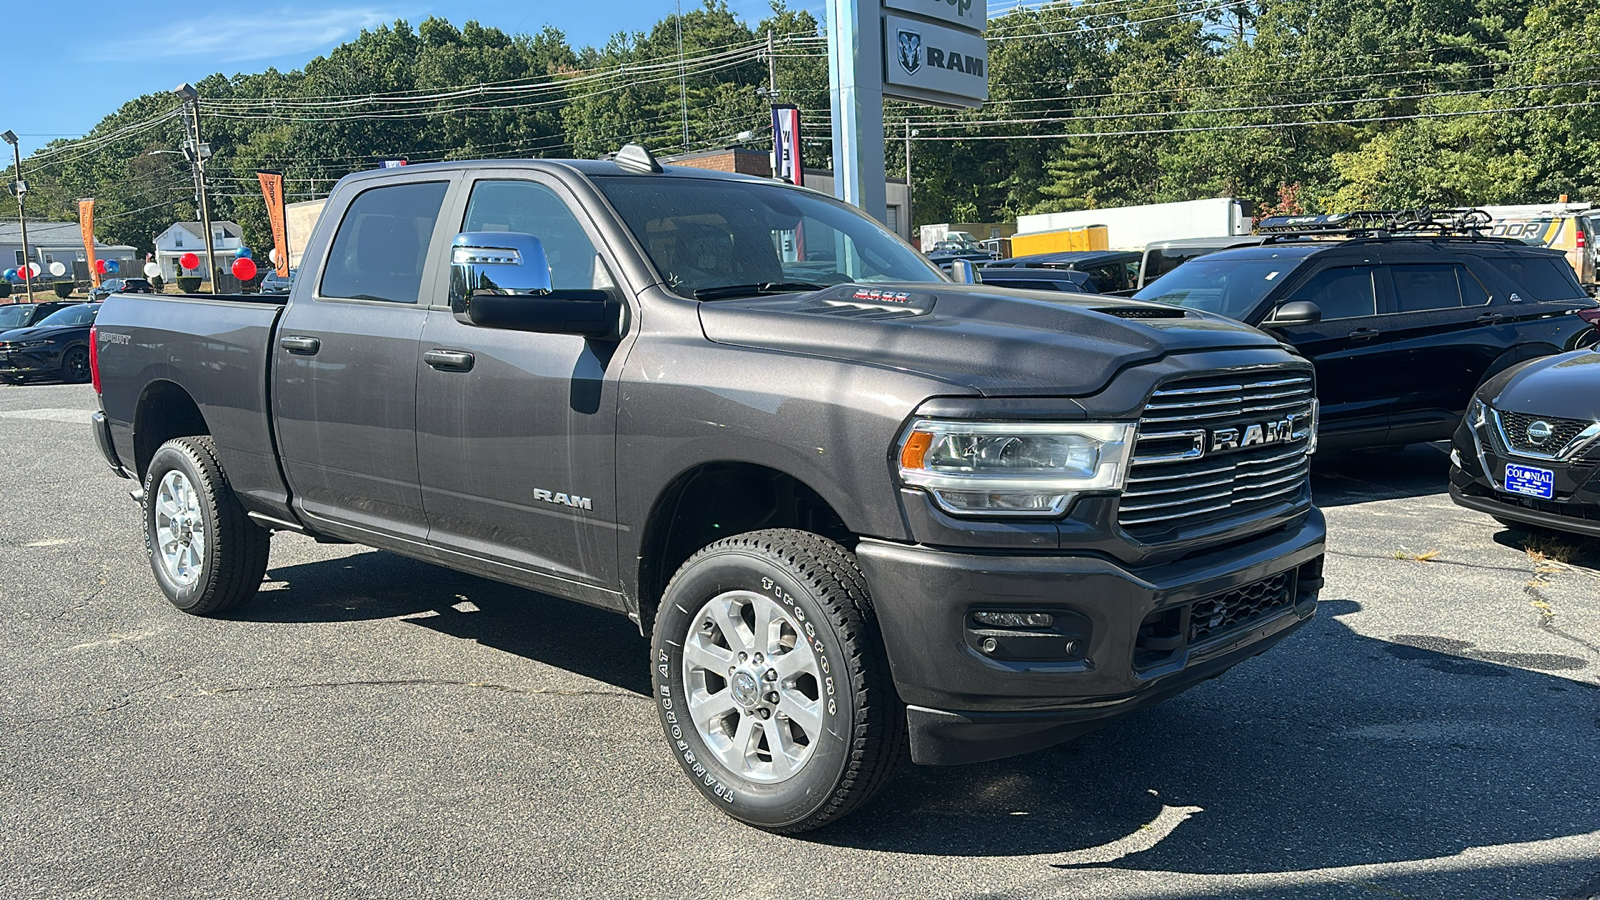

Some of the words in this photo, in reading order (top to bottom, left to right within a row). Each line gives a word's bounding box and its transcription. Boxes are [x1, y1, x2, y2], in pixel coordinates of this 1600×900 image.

[926, 46, 984, 78] RAM
[99, 331, 132, 346] SPORT
[1211, 420, 1291, 451] RAM
[533, 487, 594, 511] RAM
[658, 648, 670, 679] AT
[660, 685, 735, 804] TRANSFORCE
